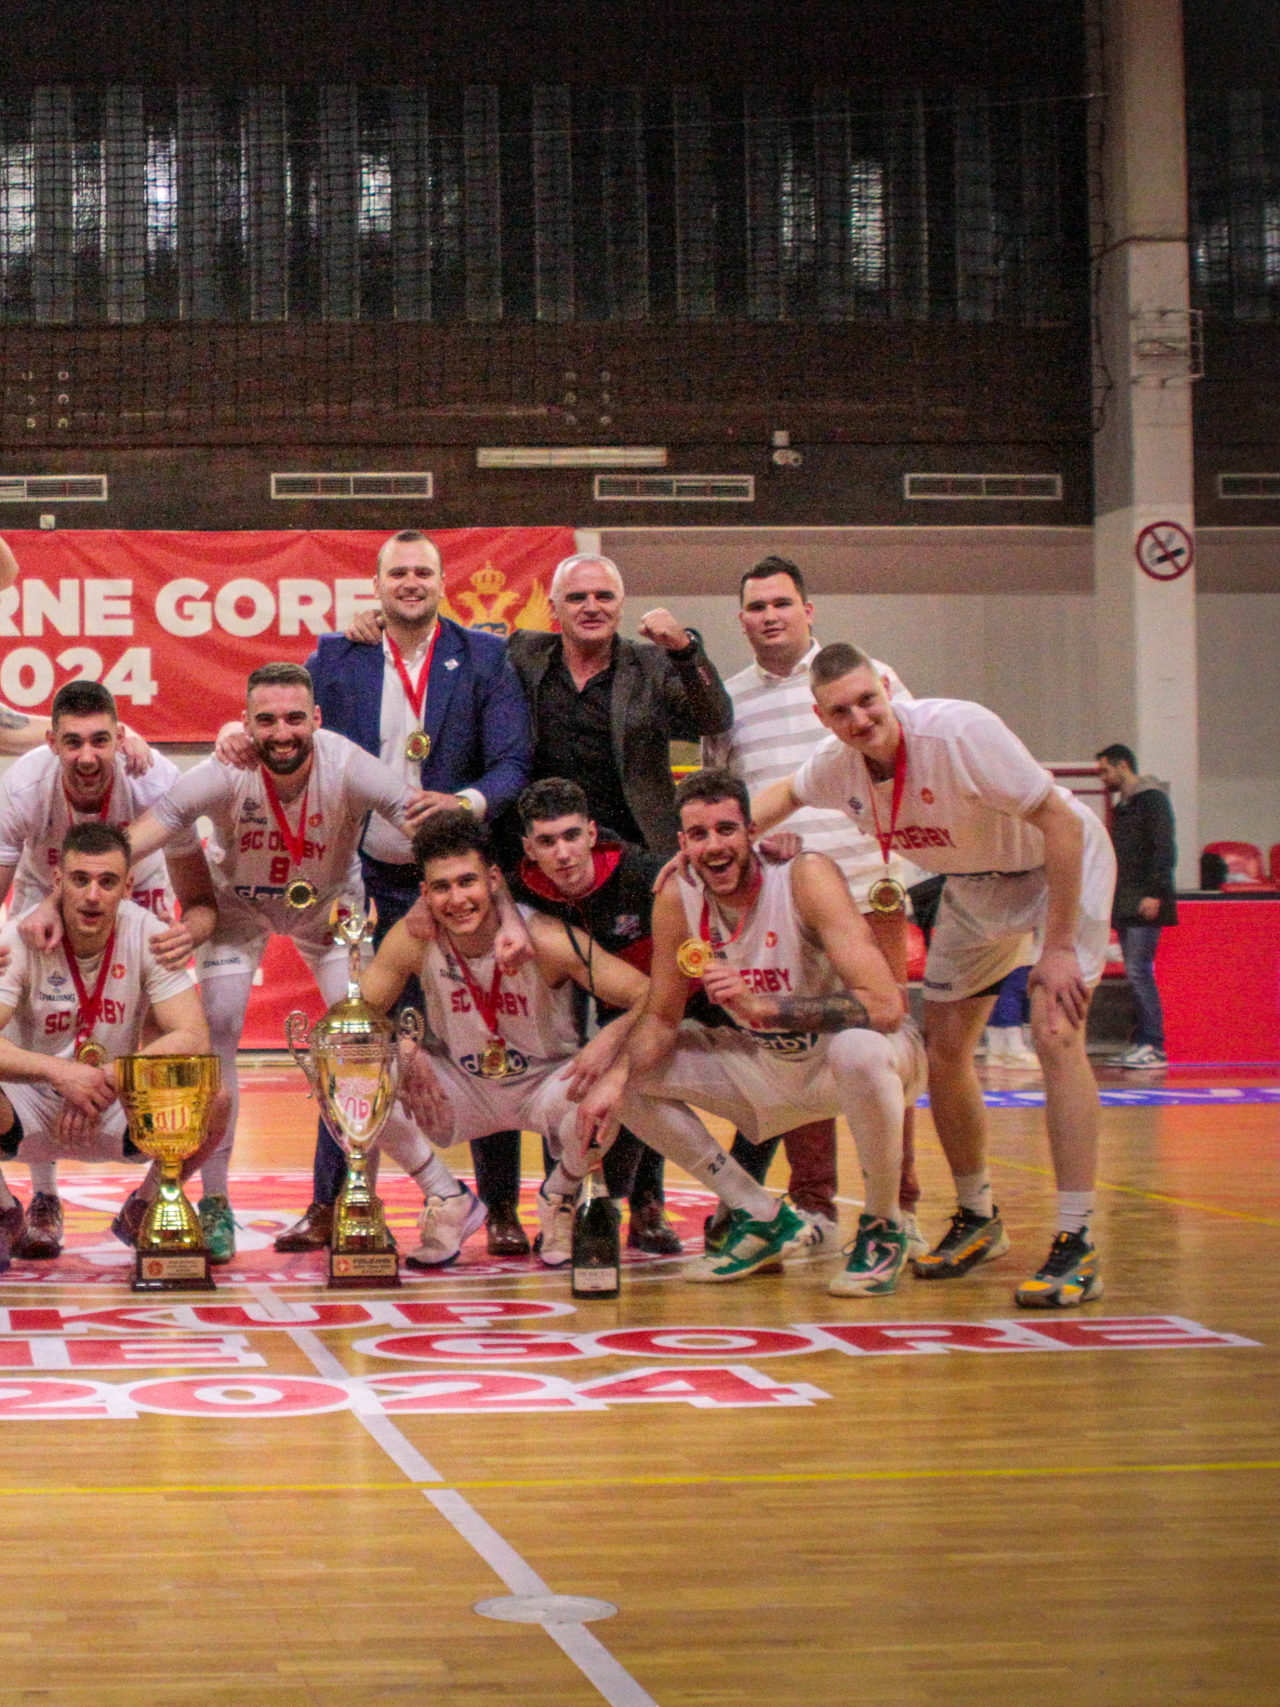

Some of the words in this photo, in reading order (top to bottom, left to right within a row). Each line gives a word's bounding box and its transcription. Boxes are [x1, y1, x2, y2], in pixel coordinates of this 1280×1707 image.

[241, 831, 264, 853] SC
[268, 831, 326, 861] DEBY
[269, 857, 290, 884] 8
[740, 968, 793, 994] ERBY
[44, 1010, 71, 1035] SC
[351, 1314, 1264, 1363] GORE
